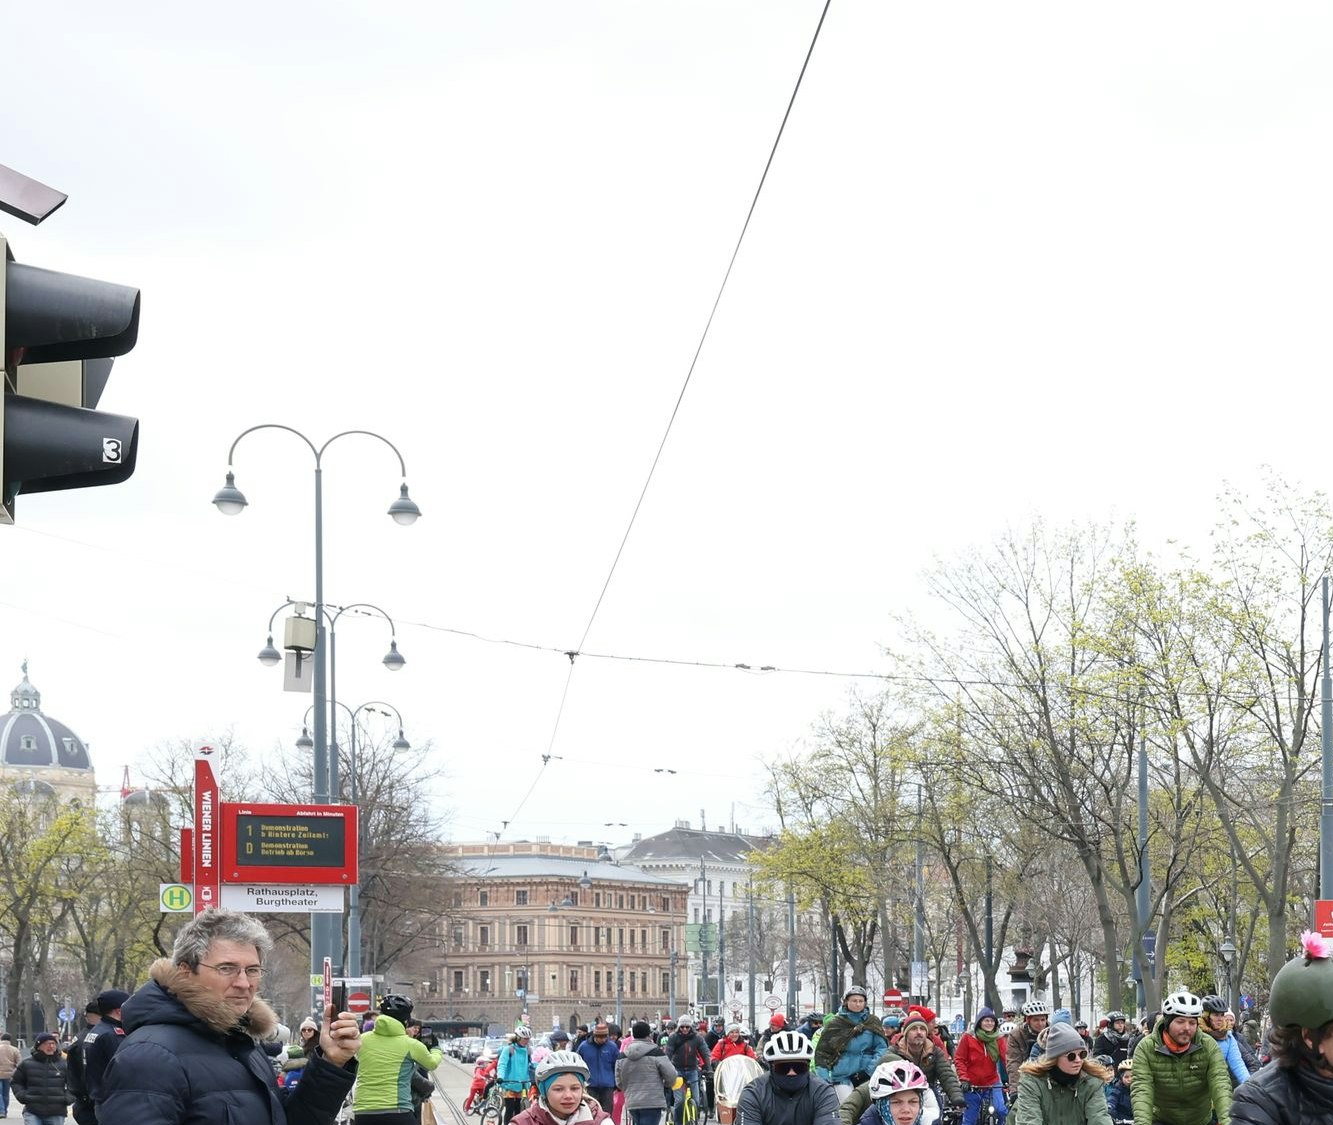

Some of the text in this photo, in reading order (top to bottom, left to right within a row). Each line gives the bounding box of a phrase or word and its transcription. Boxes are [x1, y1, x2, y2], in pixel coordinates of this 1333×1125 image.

[104, 439, 121, 461] 3
[202, 790, 212, 868] WIENER LINIEN
[246, 825, 253, 836] 1
[247, 888, 318, 897] Rathausplatz,
[256, 898, 318, 907] Burgtheater
